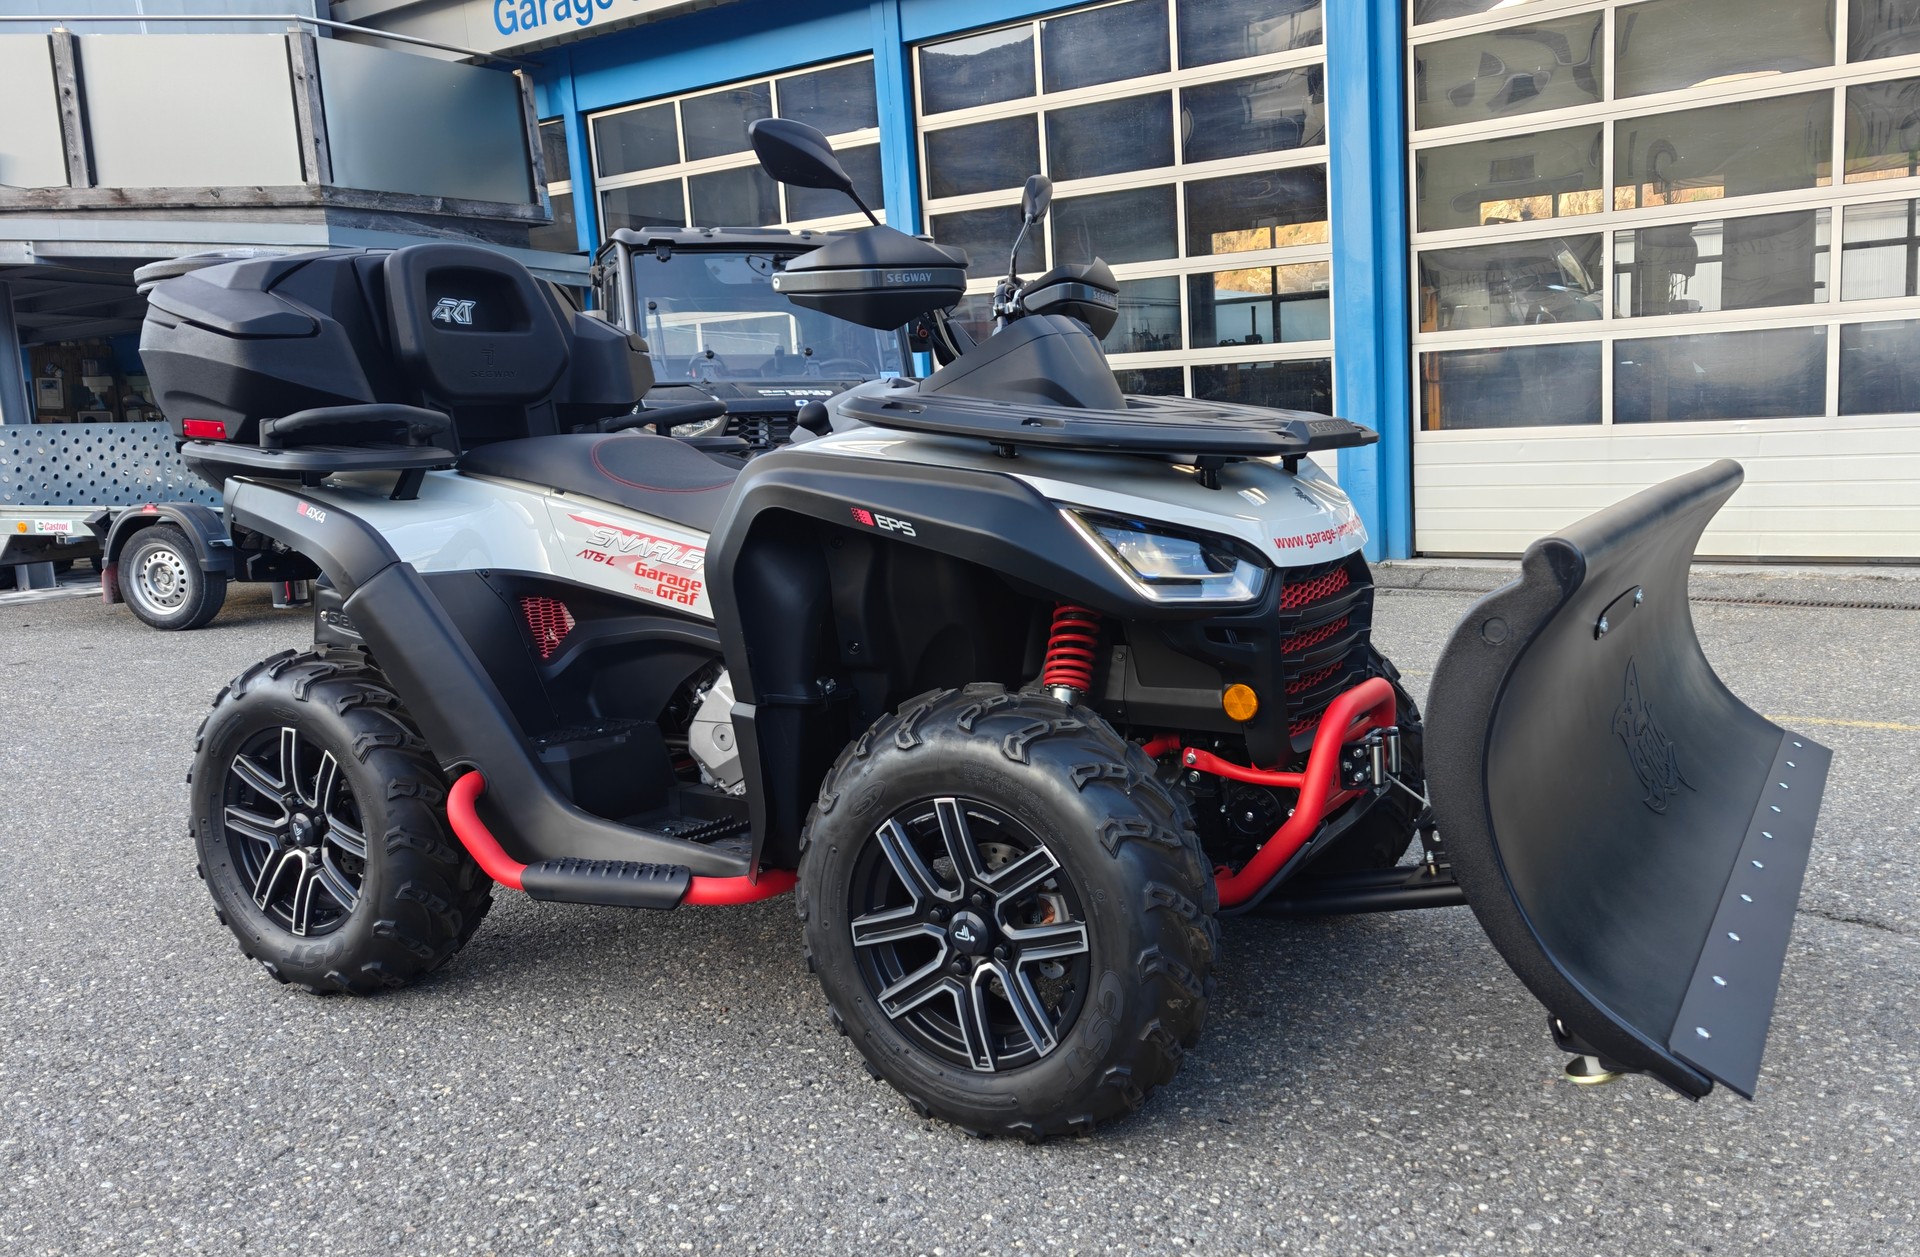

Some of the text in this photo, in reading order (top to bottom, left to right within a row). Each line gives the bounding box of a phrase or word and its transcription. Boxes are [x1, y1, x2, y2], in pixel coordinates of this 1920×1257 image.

[886, 272, 932, 283] SEGWAY
[471, 370, 518, 379] SEGWAY
[44, 522, 68, 531] Castrol
[874, 513, 917, 537] EPS
[634, 562, 702, 593] Garage
[656, 583, 700, 606] Graf
[282, 936, 344, 970] CST
[1063, 970, 1124, 1091] CST
